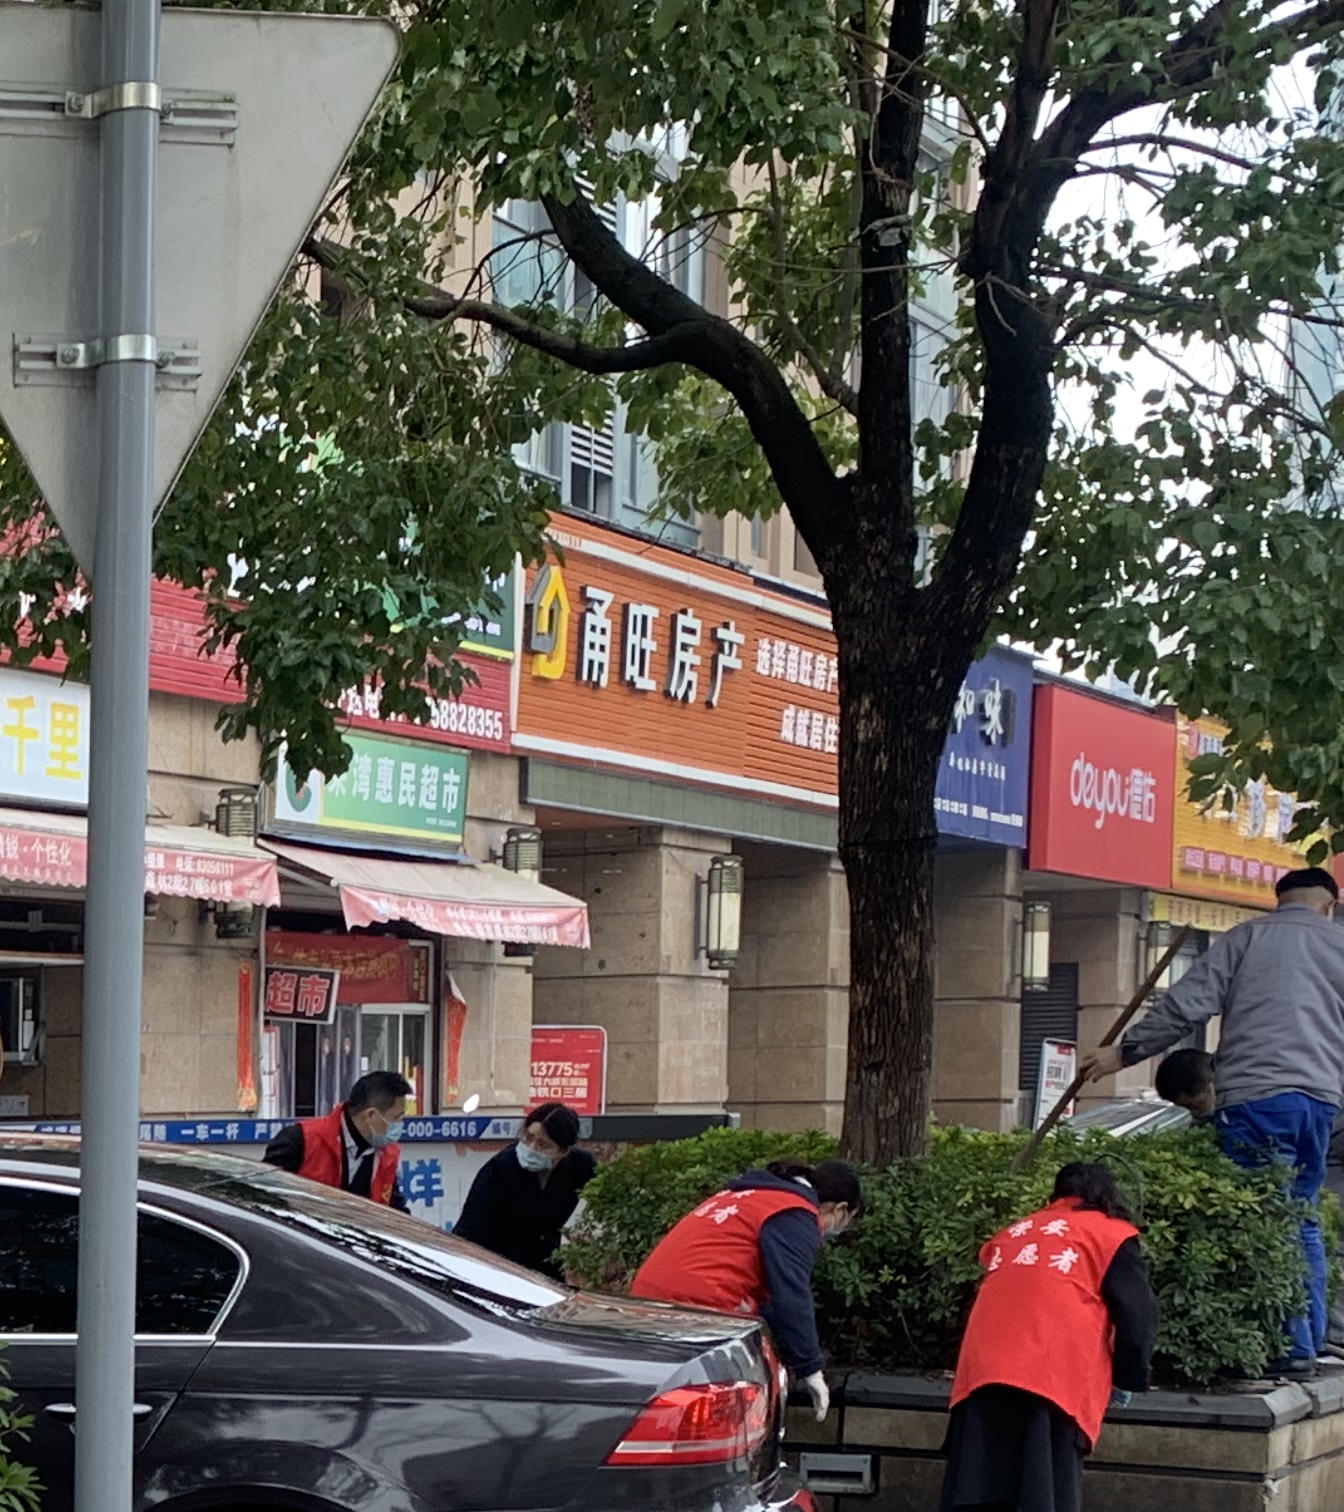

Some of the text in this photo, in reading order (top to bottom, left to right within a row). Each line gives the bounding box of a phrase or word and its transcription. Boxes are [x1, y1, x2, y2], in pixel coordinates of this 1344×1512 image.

[582, 586, 745, 708] 甬旺房产
[266, 971, 331, 1016] 超市
[531, 1061, 573, 1077] 13775
[181, 1123, 239, 1141] 一车一杆
